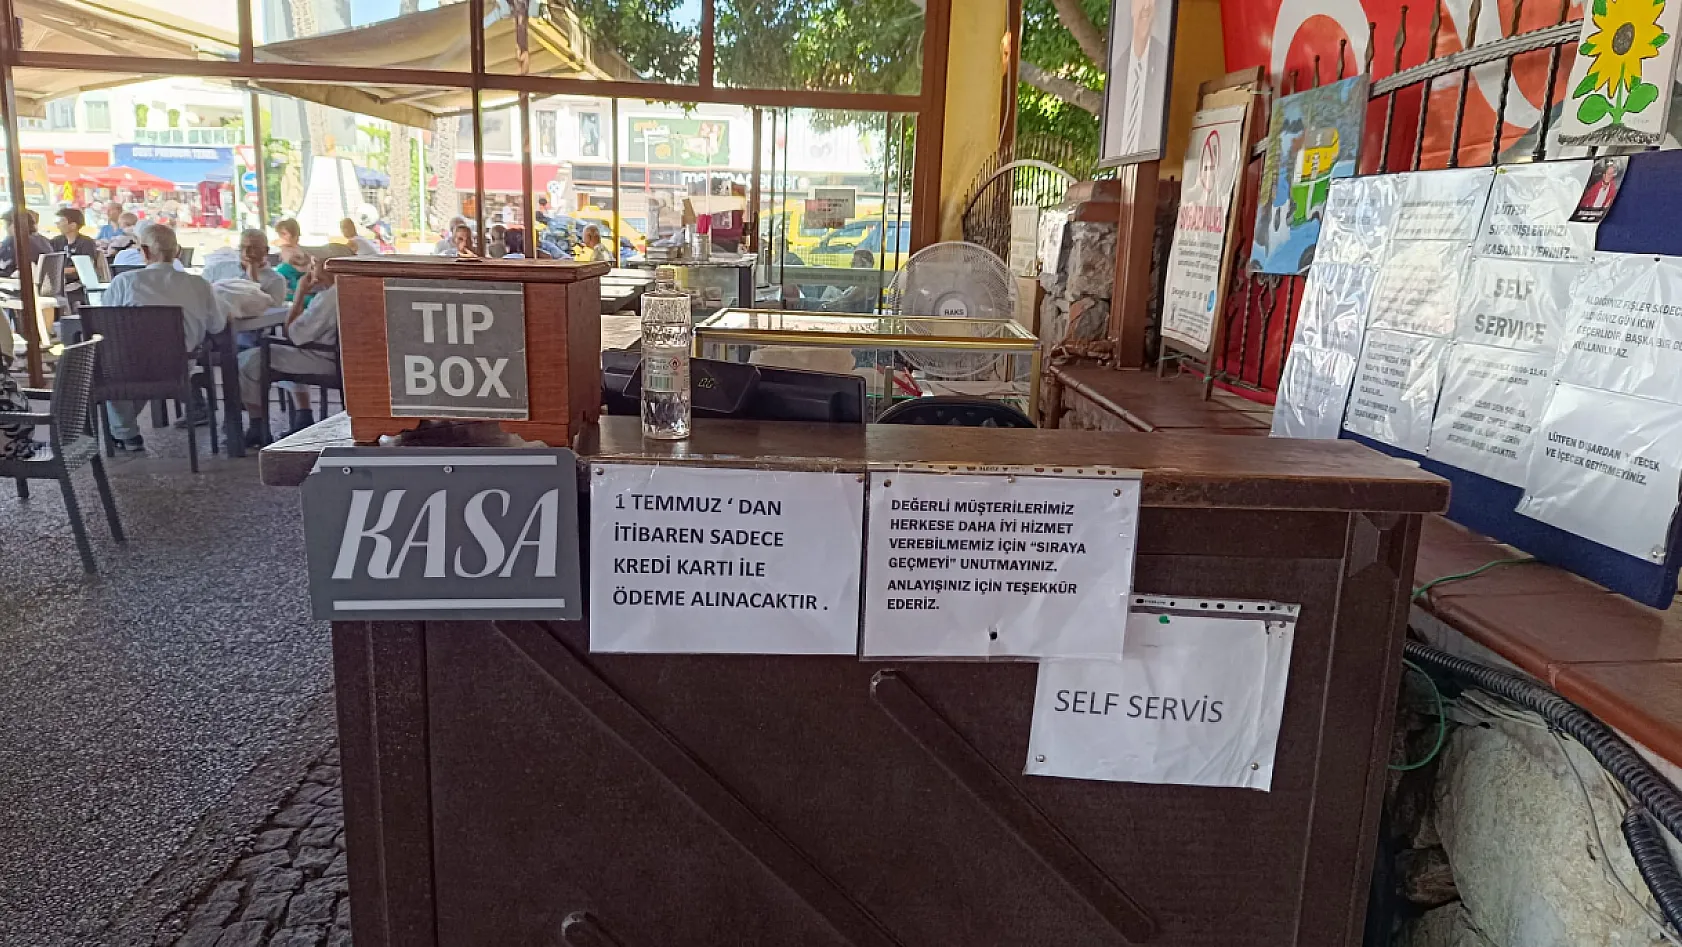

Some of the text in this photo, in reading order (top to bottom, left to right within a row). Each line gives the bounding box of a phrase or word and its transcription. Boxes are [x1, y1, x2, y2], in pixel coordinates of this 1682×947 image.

[1494, 278, 1536, 300] SELF
[412, 302, 494, 344] TIP
[1474, 314, 1547, 344] SERVICE
[404, 354, 511, 398] BOX
[1546, 446, 1556, 458] VE
[1548, 432, 1576, 448] LÜTFEN
[1624, 452, 1660, 472] YYECEK
[616, 494, 626, 509] 1
[631, 494, 722, 513] TEMMUZ
[891, 498, 1074, 516] DEĞERLİ MÜŞTERİLERİMİZ
[332, 488, 558, 579] KASA
[614, 522, 784, 548] İTİBAREN SADECE
[890, 518, 1074, 534] HERKESE DAHA İYİ HİZMET
[889, 537, 994, 552] VEREBİLMEMİZ
[998, 538, 1026, 554] İÇİN
[614, 555, 766, 578] KREDİ KARTI İLE
[960, 558, 1058, 572] UNUTMAYINIZ.
[612, 586, 685, 606] ÖDEME
[887, 578, 1077, 596] ANLAYIŞINIZ İÇİN TEŞEKKÜR
[887, 597, 940, 610] EDERİZ.
[1054, 690, 1223, 723] SELF SERVİS
